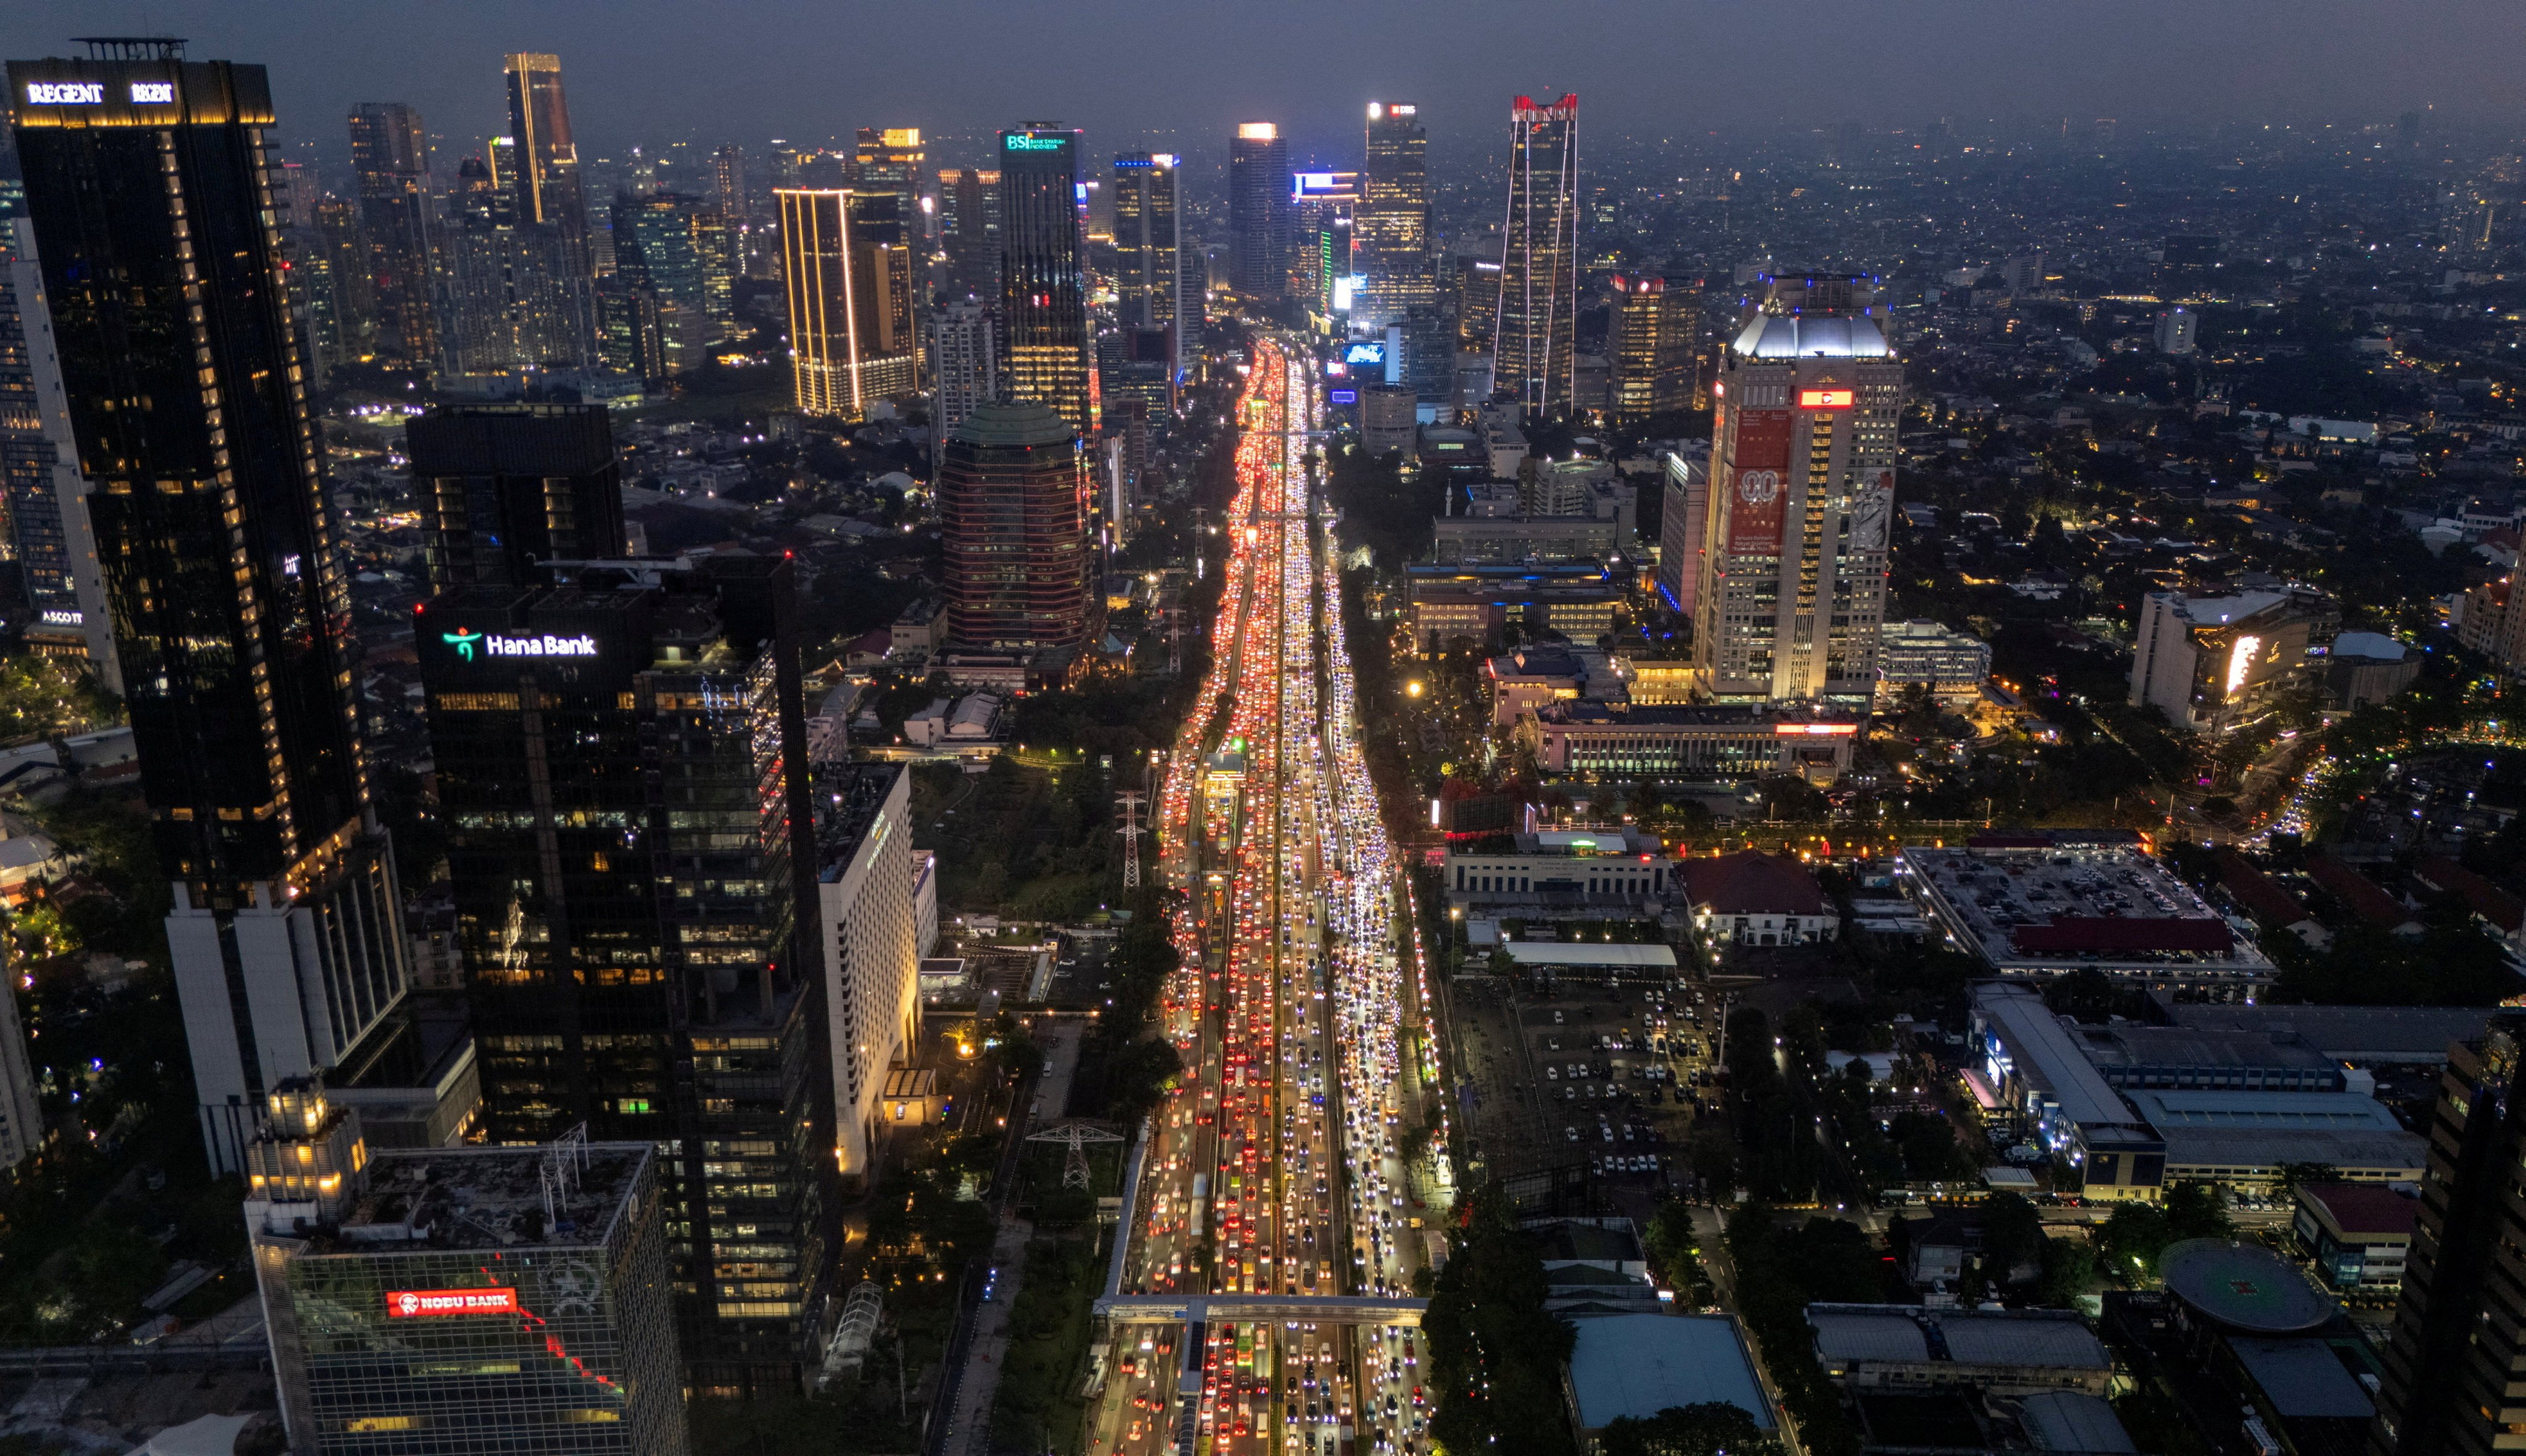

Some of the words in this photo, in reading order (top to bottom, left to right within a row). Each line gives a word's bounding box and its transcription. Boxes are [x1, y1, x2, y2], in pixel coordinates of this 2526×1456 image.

[28, 83, 104, 104] REGENT
[131, 83, 173, 103] REGENT
[1400, 105, 1416, 114] DBS
[1007, 135, 1030, 149] BSI
[1741, 470, 1779, 501] 80
[43, 611, 83, 623] ASCOTT
[487, 635, 543, 654] Hana
[543, 635, 596, 654] Bank
[420, 1297, 463, 1309] NOBU
[466, 1294, 509, 1307] BANK
